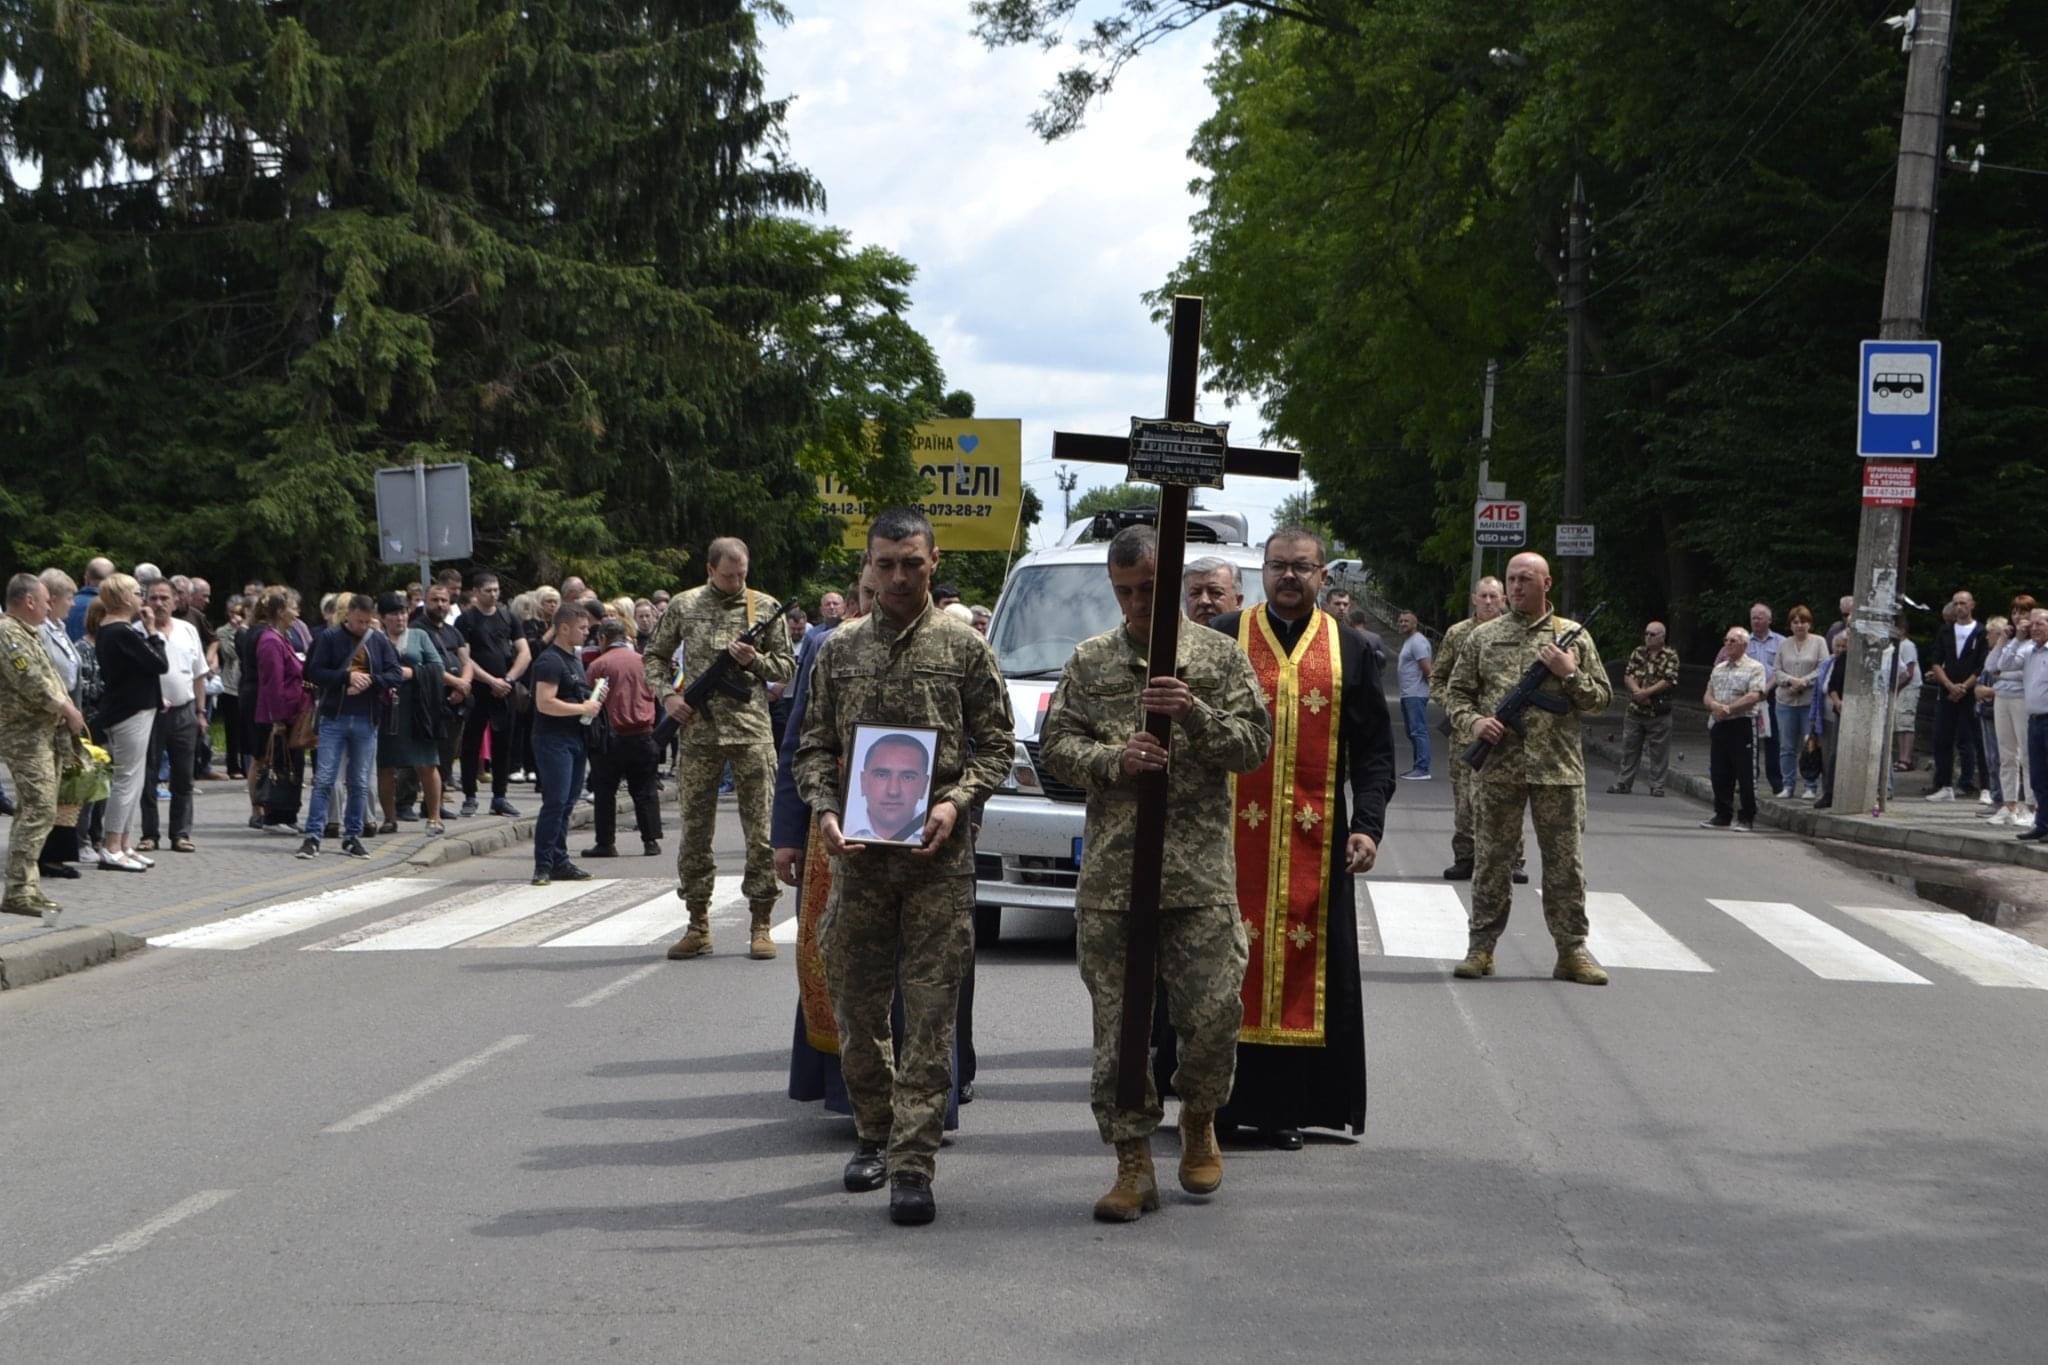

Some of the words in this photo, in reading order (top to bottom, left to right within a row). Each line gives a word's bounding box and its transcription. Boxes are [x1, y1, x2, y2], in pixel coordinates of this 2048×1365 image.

[911, 434, 953, 450] КРАЇНА
[919, 464, 999, 496] СТЕЛІ
[1479, 504, 1520, 520] АТБ
[1478, 533, 1499, 542] 450
